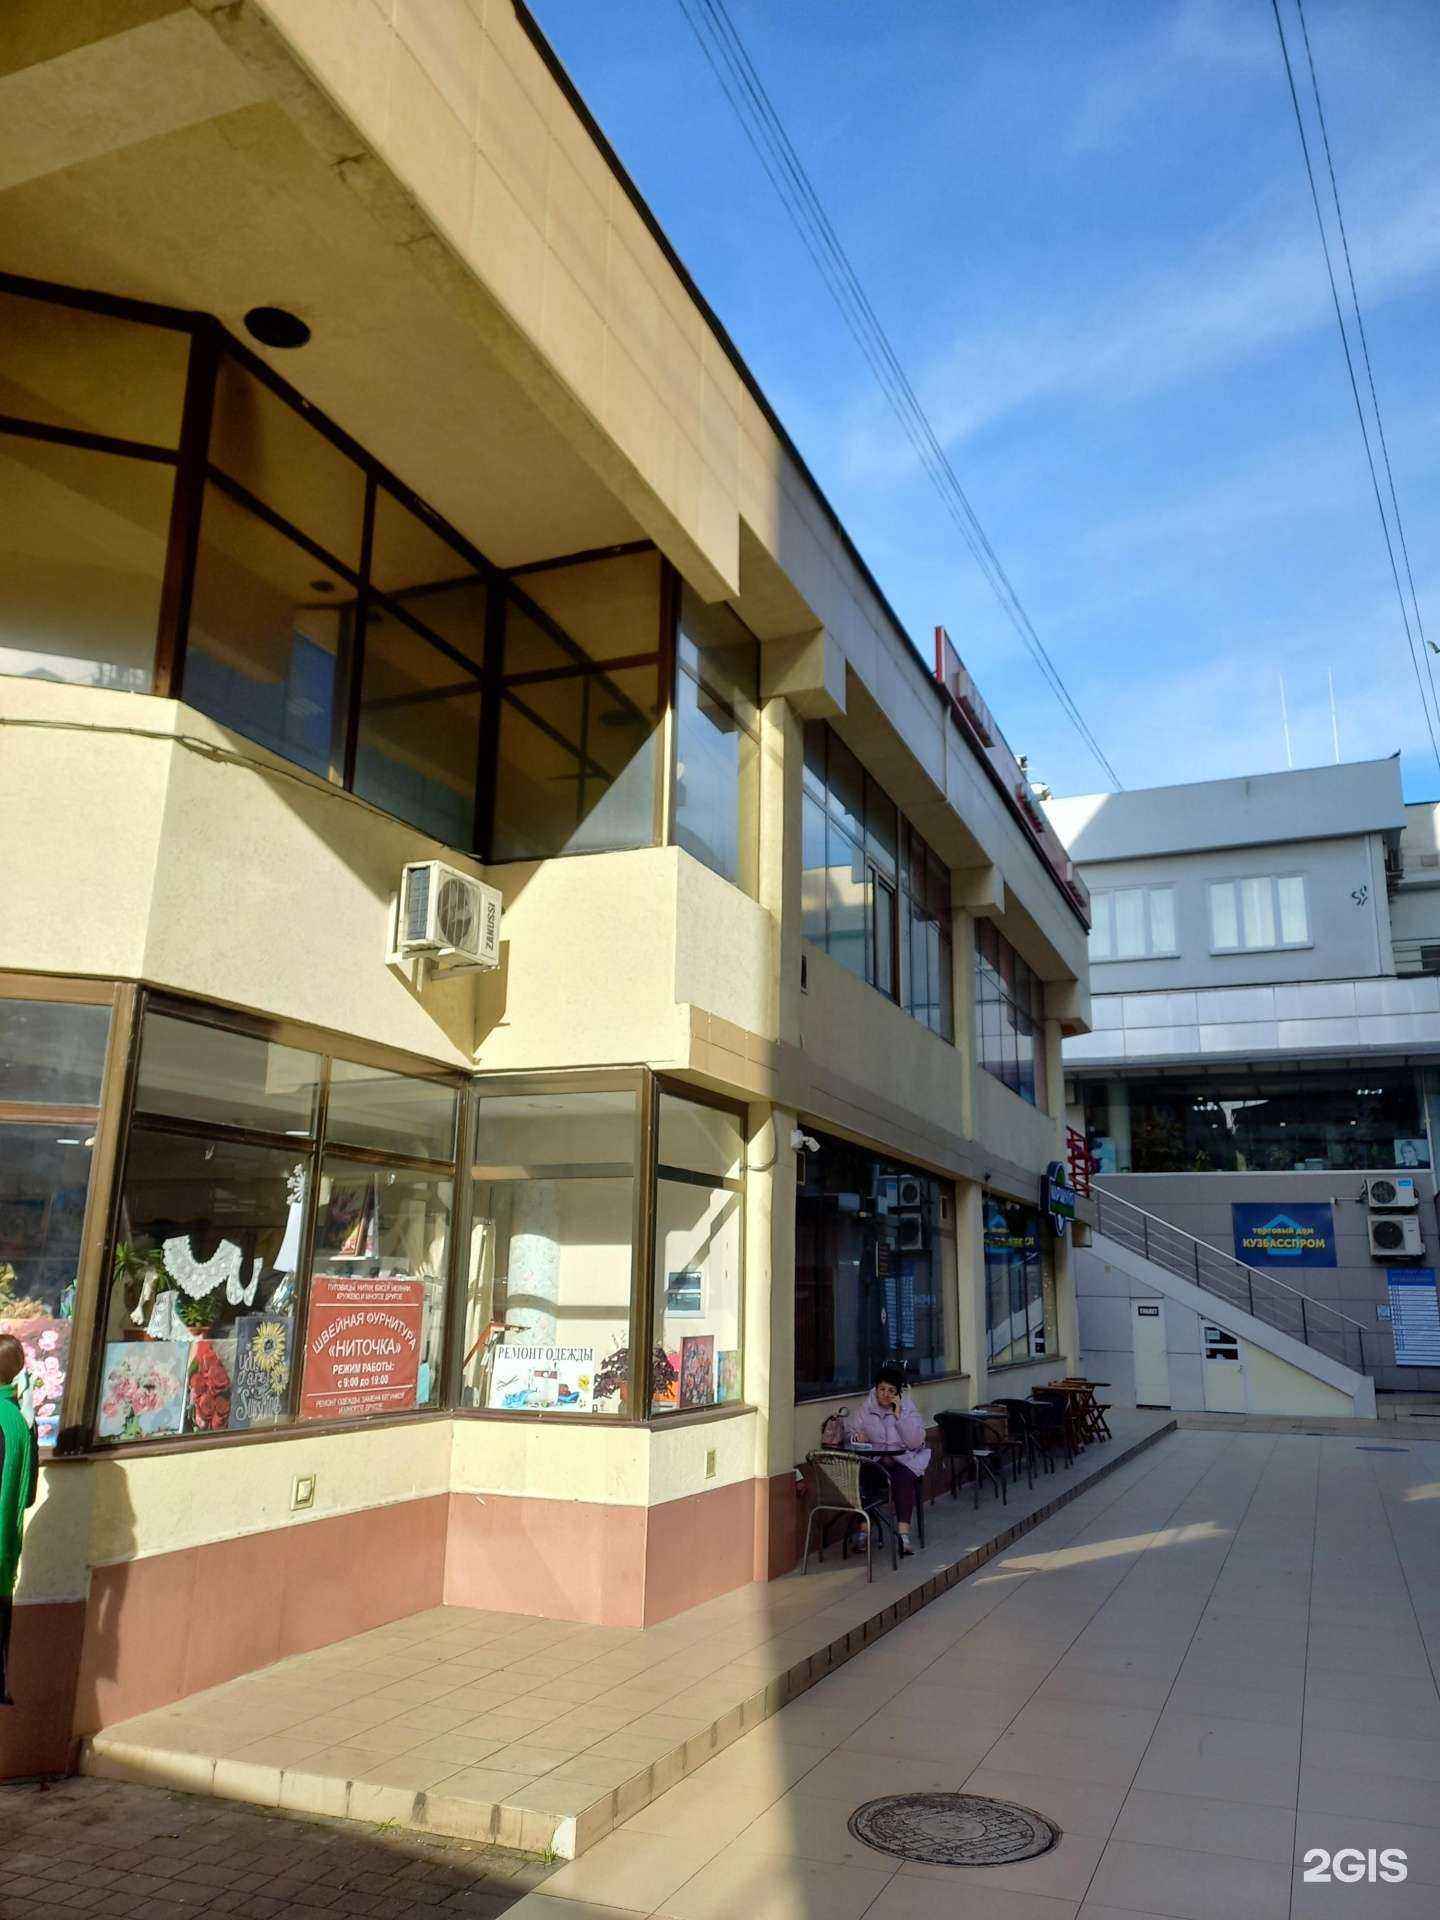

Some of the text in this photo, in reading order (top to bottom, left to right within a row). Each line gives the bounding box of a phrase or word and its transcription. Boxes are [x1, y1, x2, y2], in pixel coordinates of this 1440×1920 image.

[486, 902, 496, 952] ZANUSSI
[312, 1312, 417, 1354] ШВЕЙНАЯ ФУРНИТУРА
[328, 1338, 402, 1358] «НИТОЧКА»
[498, 1346, 594, 1362] РЕМОНТ ОДЕЖДЫ
[332, 1362, 394, 1375] РЕЖИМ РАБОТЫ:
